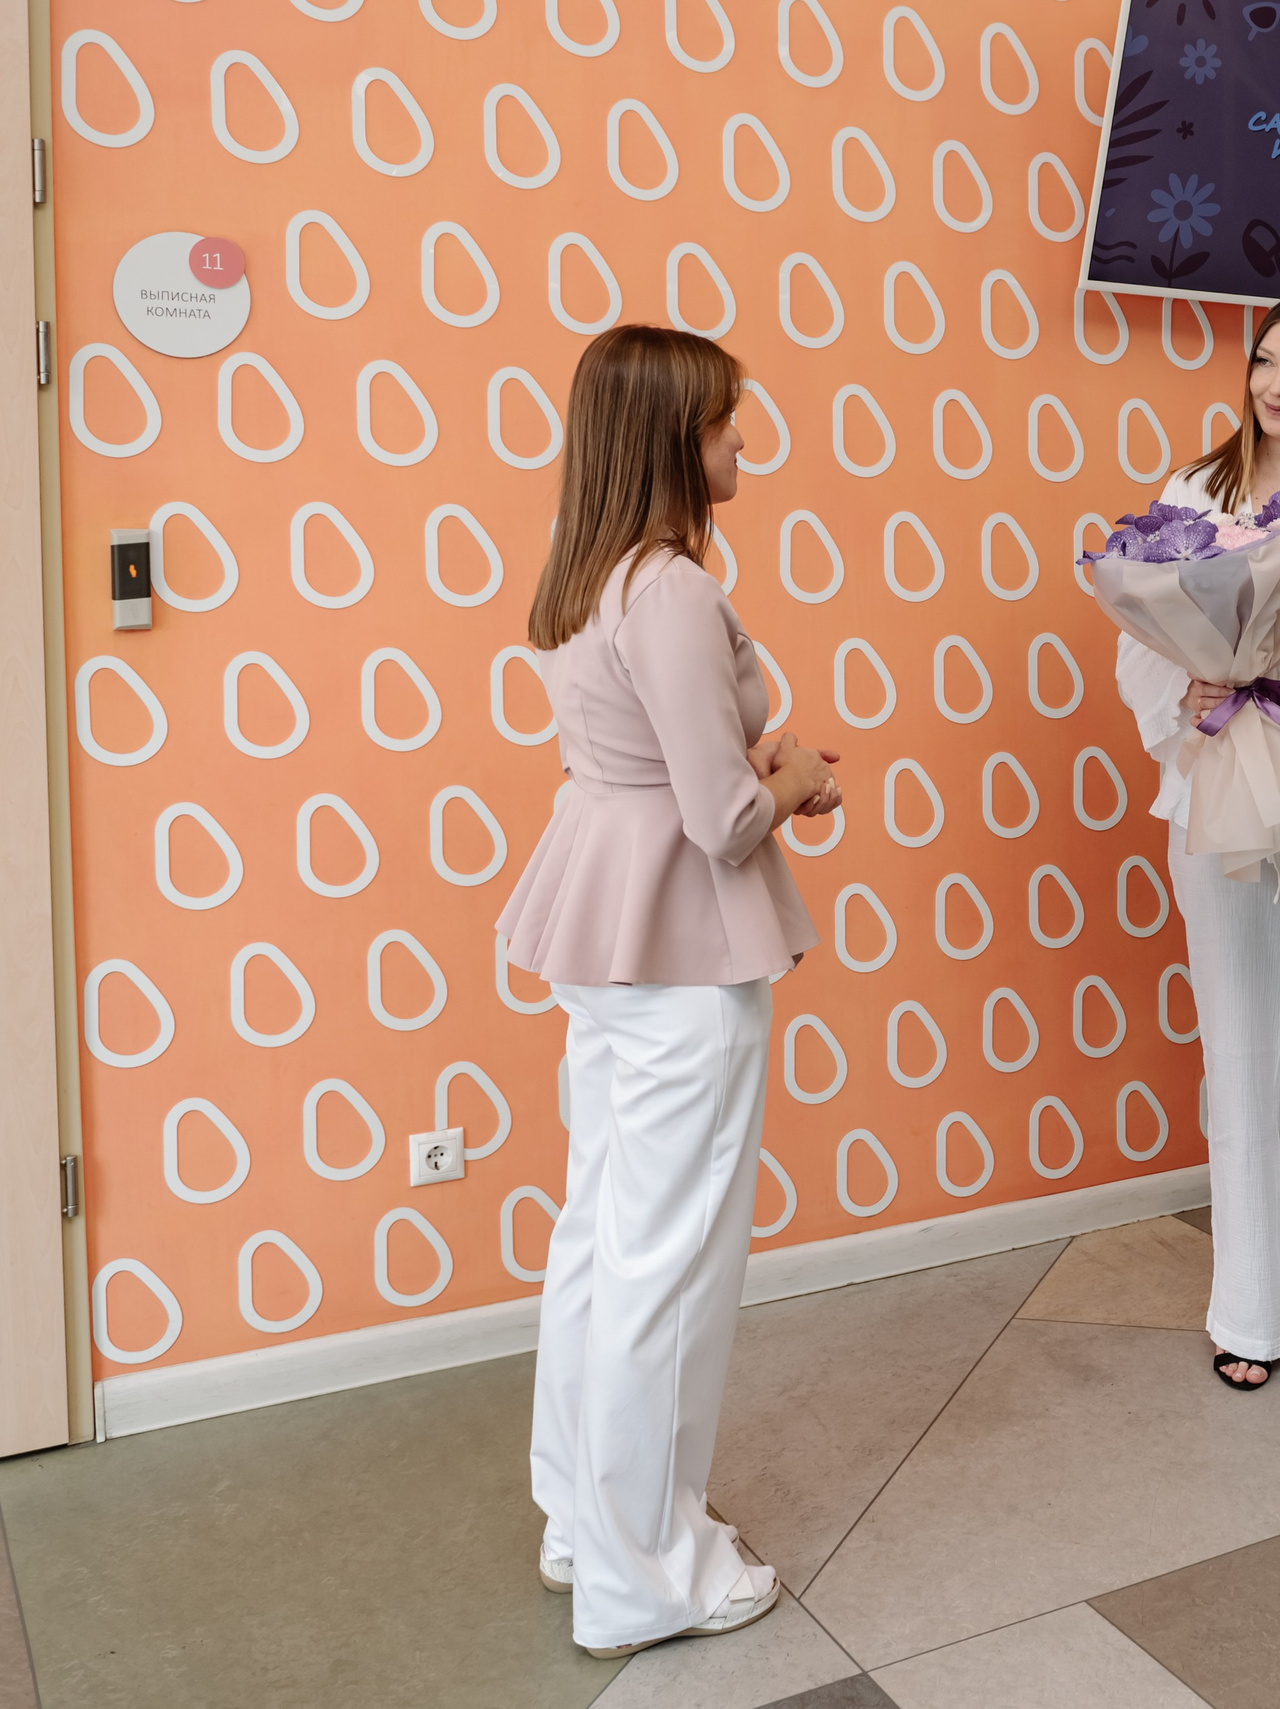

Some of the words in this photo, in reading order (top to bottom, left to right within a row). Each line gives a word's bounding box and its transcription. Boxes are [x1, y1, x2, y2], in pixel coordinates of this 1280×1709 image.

[202, 252, 224, 270] 11
[140, 289, 216, 304] ВЫПИСНАЯ
[146, 306, 211, 319] КОМНАТА
